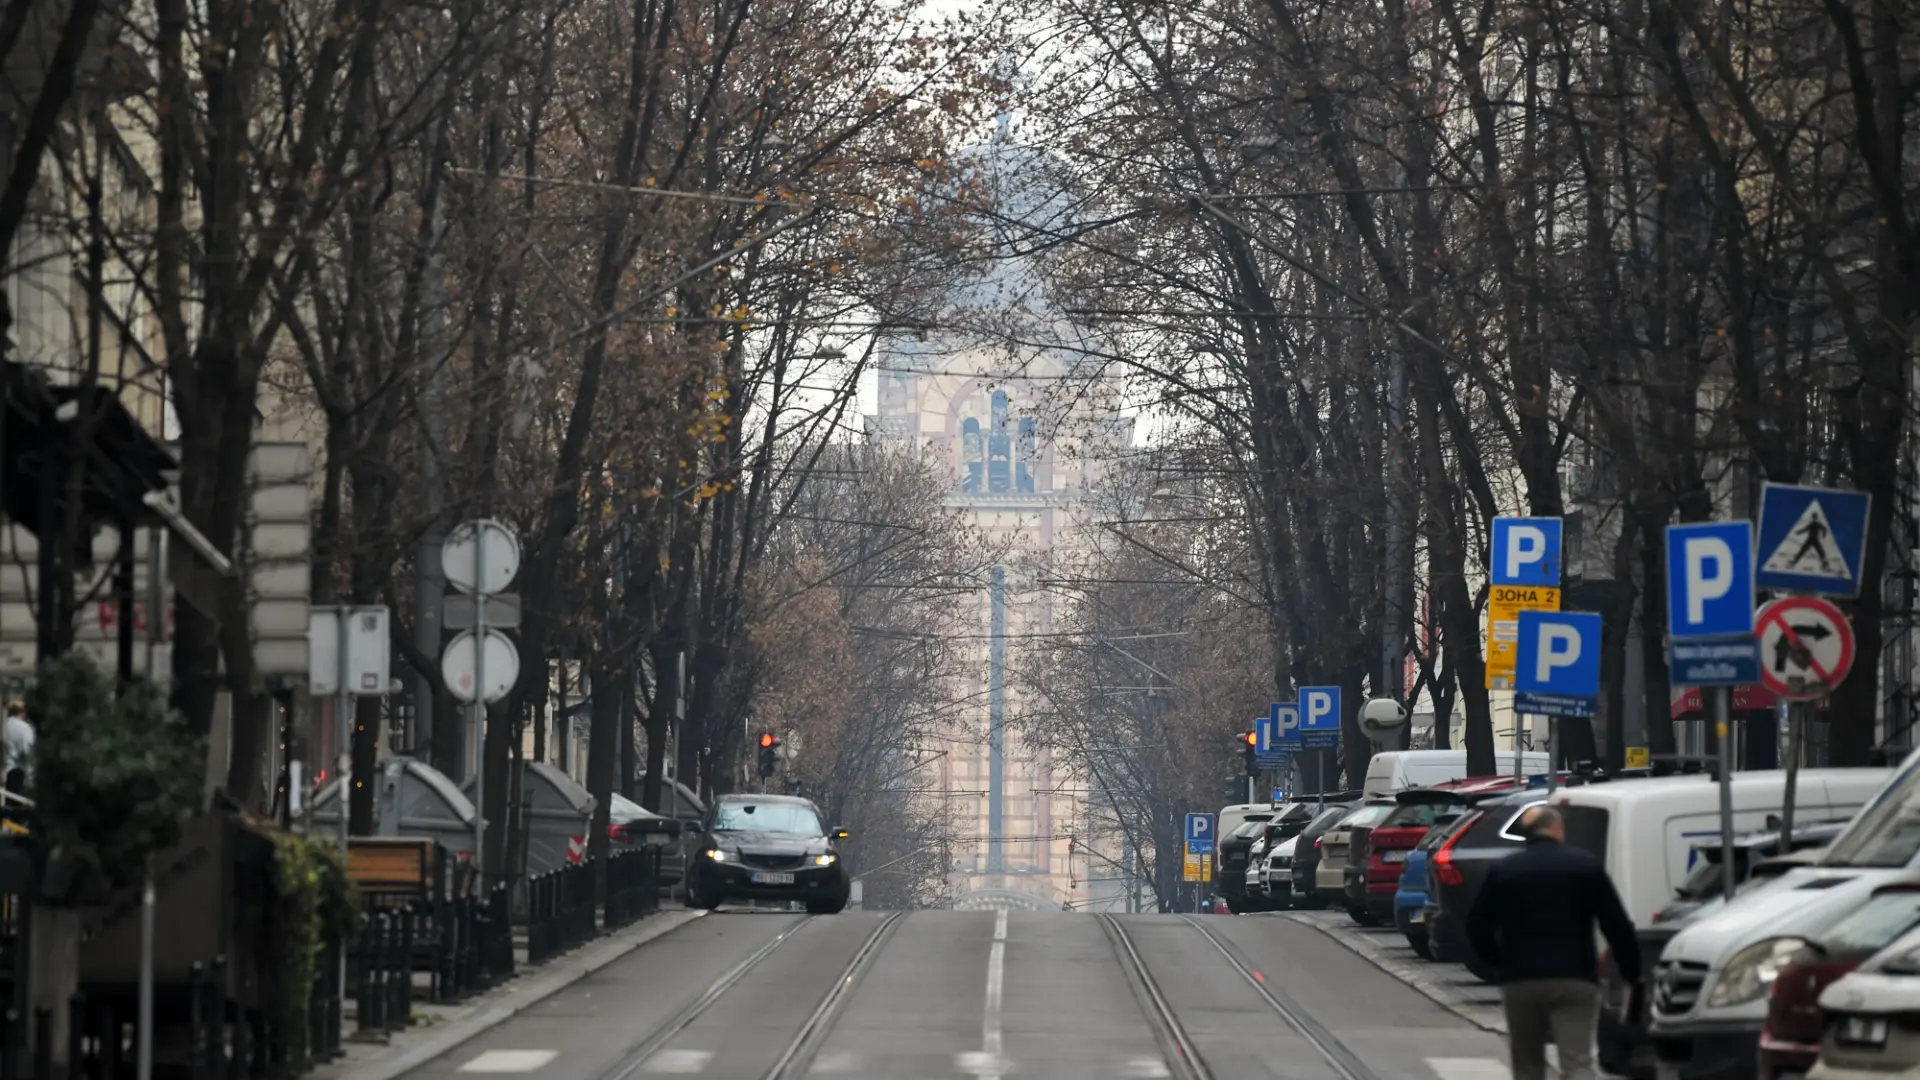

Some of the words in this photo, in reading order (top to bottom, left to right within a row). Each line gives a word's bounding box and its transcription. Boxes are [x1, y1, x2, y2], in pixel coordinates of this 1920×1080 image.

[1507, 526, 1545, 577] P
[1495, 589, 1538, 602] ЗОНА
[1546, 591, 1555, 603] 2
[1685, 537, 1733, 624] P
[1536, 622, 1581, 681] P
[1278, 707, 1299, 737] P
[1308, 691, 1332, 725] P
[1193, 817, 1208, 838] P
